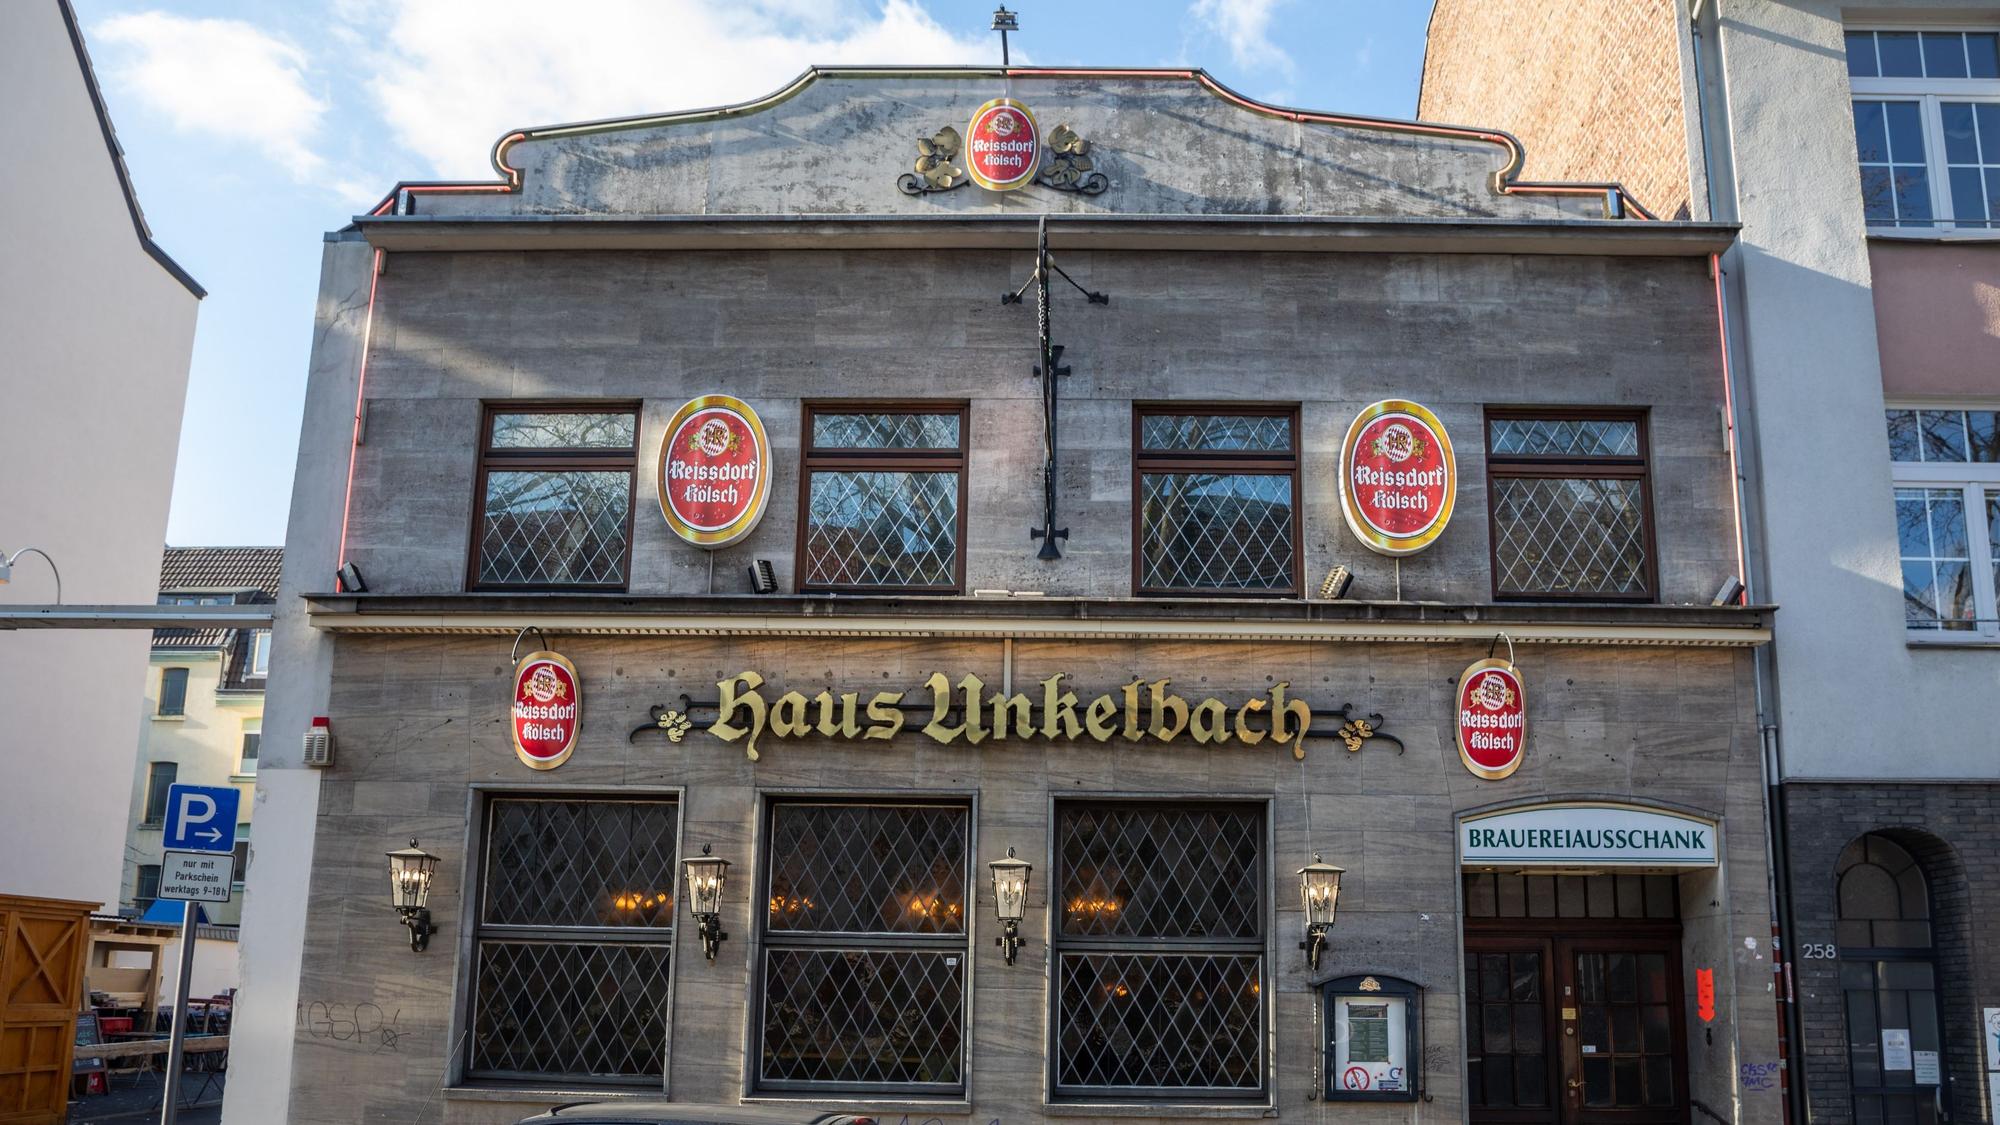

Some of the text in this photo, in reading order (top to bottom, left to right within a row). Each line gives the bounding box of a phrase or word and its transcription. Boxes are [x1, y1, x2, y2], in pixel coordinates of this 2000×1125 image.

[973, 139, 1034, 153] Reissdorf
[984, 154, 1022, 168] Kölsch
[669, 459, 757, 481] Reissdorf
[1355, 465, 1445, 487] Reissdorf
[684, 483, 738, 506] Kölsch
[1373, 489, 1428, 512] Kölsch
[515, 701, 575, 720] Reissdorf
[707, 670, 1312, 762] Haus Unkelbach
[1461, 709, 1523, 729] Reissdorf
[523, 721, 565, 743] Kölsch
[1470, 730, 1514, 752] Kölsch
[175, 792, 217, 841] P
[1469, 828, 1706, 849] BRAUEREIAUSSCHANK
[183, 860, 214, 869] nur mit
[175, 871, 219, 883] Parkschein
[164, 885, 199, 896] werktags
[1802, 943, 1837, 960] 258
